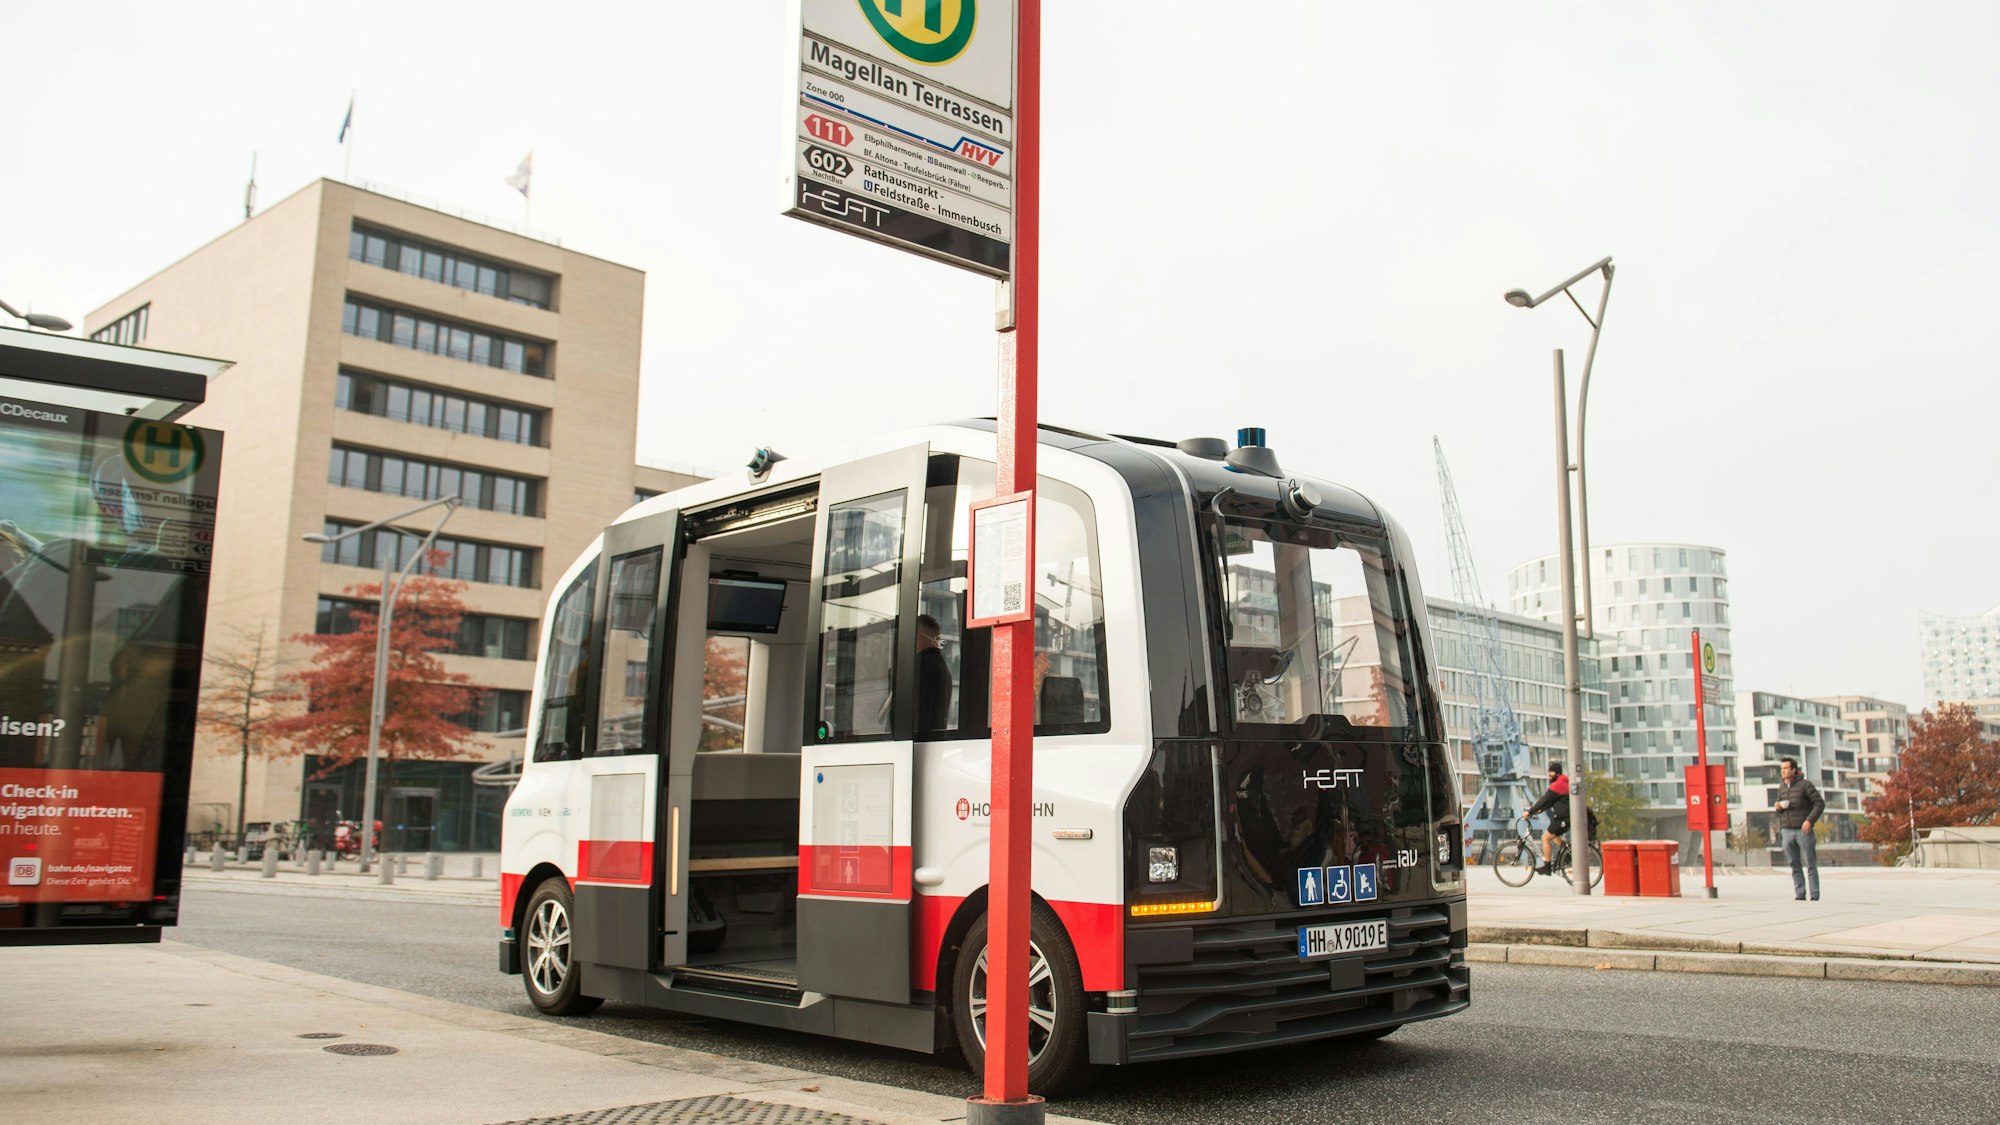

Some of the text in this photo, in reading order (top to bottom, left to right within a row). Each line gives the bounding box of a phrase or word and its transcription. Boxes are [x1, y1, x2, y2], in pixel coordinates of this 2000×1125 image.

[806, 82, 845, 103] Zone 000
[810, 41, 1004, 134] Magellan Terrassen
[812, 117, 847, 146] 111
[810, 149, 847, 177] 602
[864, 133, 923, 160] Elbphilharmonie
[934, 158, 967, 176] Baumwall
[977, 174, 1005, 190] Reeperb.
[961, 142, 1001, 168] HVV
[813, 169, 843, 185] NachtBus
[864, 148, 874, 158] Bf.
[874, 152, 898, 167] Altona
[903, 162, 947, 183] Teufelsbrück
[947, 177, 971, 193] (Fähre)
[864, 165, 939, 200] Rathausmarkt
[803, 183, 890, 227] HEAT
[874, 183, 929, 211] Feldstraße
[938, 204, 1002, 235] Immenbusch
[0, 402, 69, 424] CDecaux
[0, 715, 66, 738] isen?
[1303, 769, 1364, 790] HEAT
[1, 783, 79, 799] Check-in
[67, 805, 133, 818] nutzen.
[14, 821, 62, 836] heute.
[16, 866, 34, 877] DB
[47, 864, 133, 874] bahn.de/navigator
[46, 877, 70, 885] Diese
[70, 877, 88, 885] Zeit
[88, 877, 115, 887] gehört
